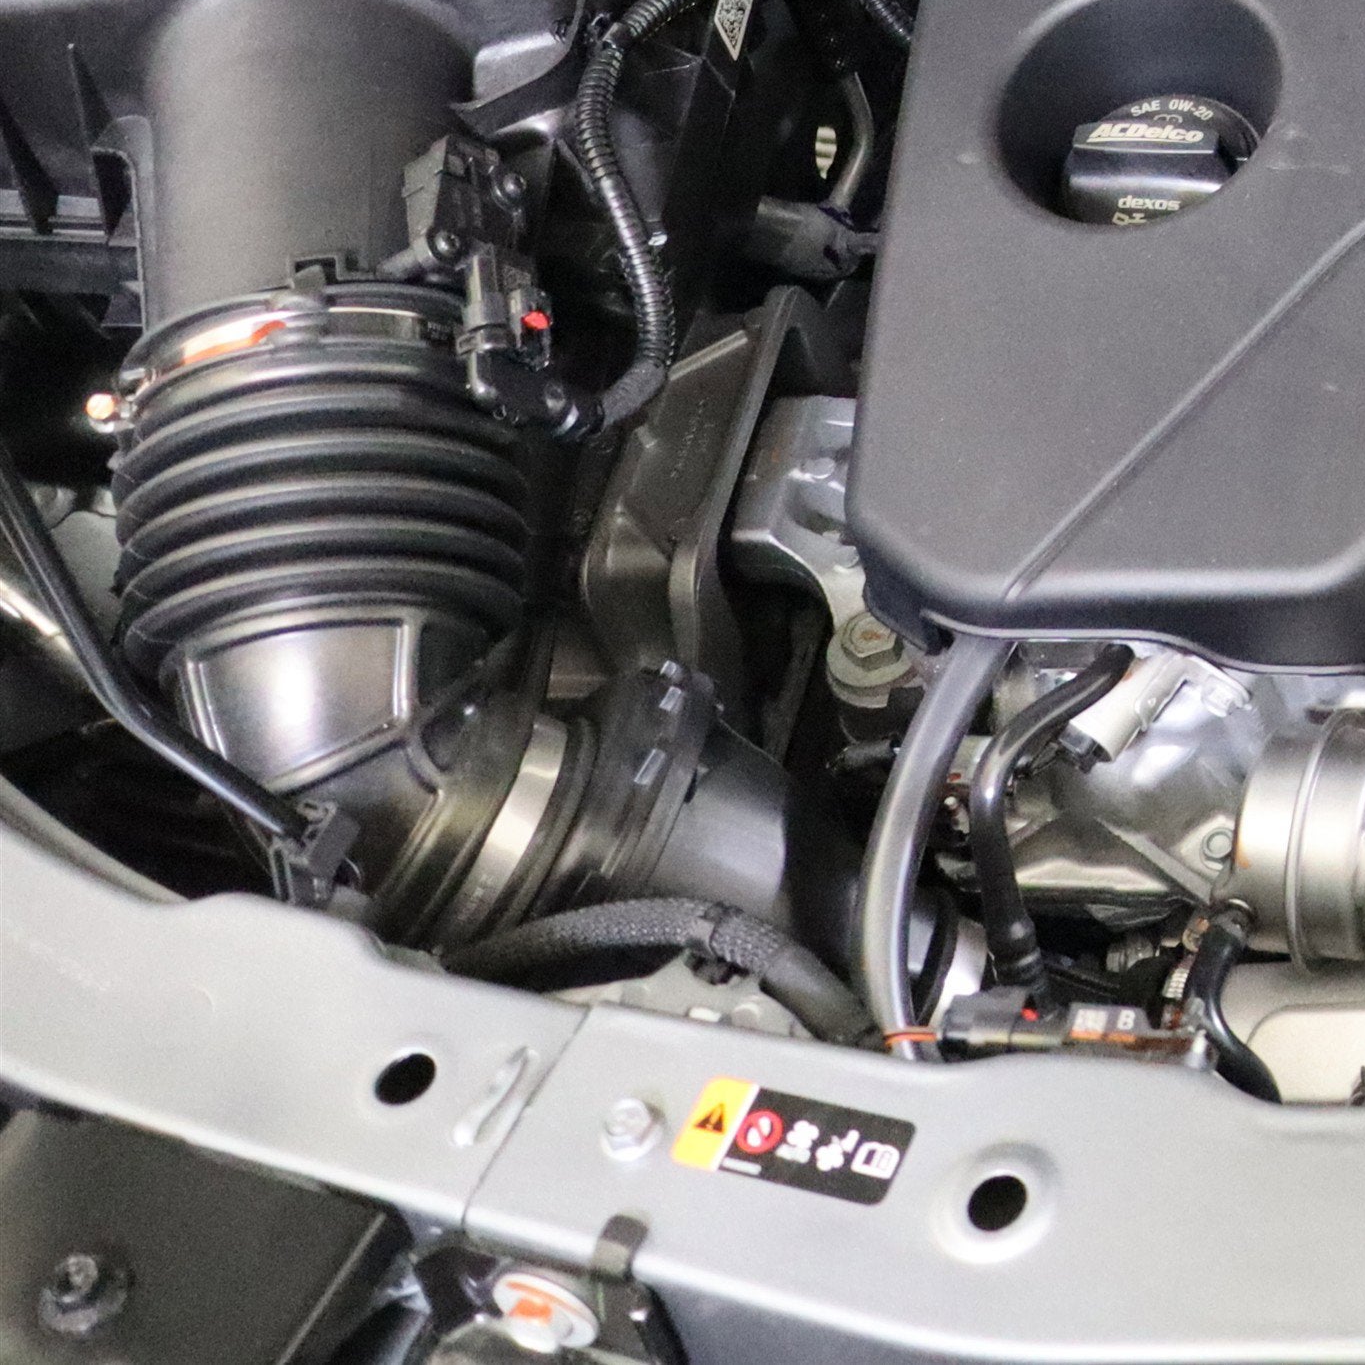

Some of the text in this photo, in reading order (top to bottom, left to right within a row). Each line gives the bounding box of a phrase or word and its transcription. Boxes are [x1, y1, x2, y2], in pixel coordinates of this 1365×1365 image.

[1130, 99, 1214, 121] SAE 0W-20
[1087, 123, 1204, 143] ACDelco
[1118, 195, 1182, 211] dexos
